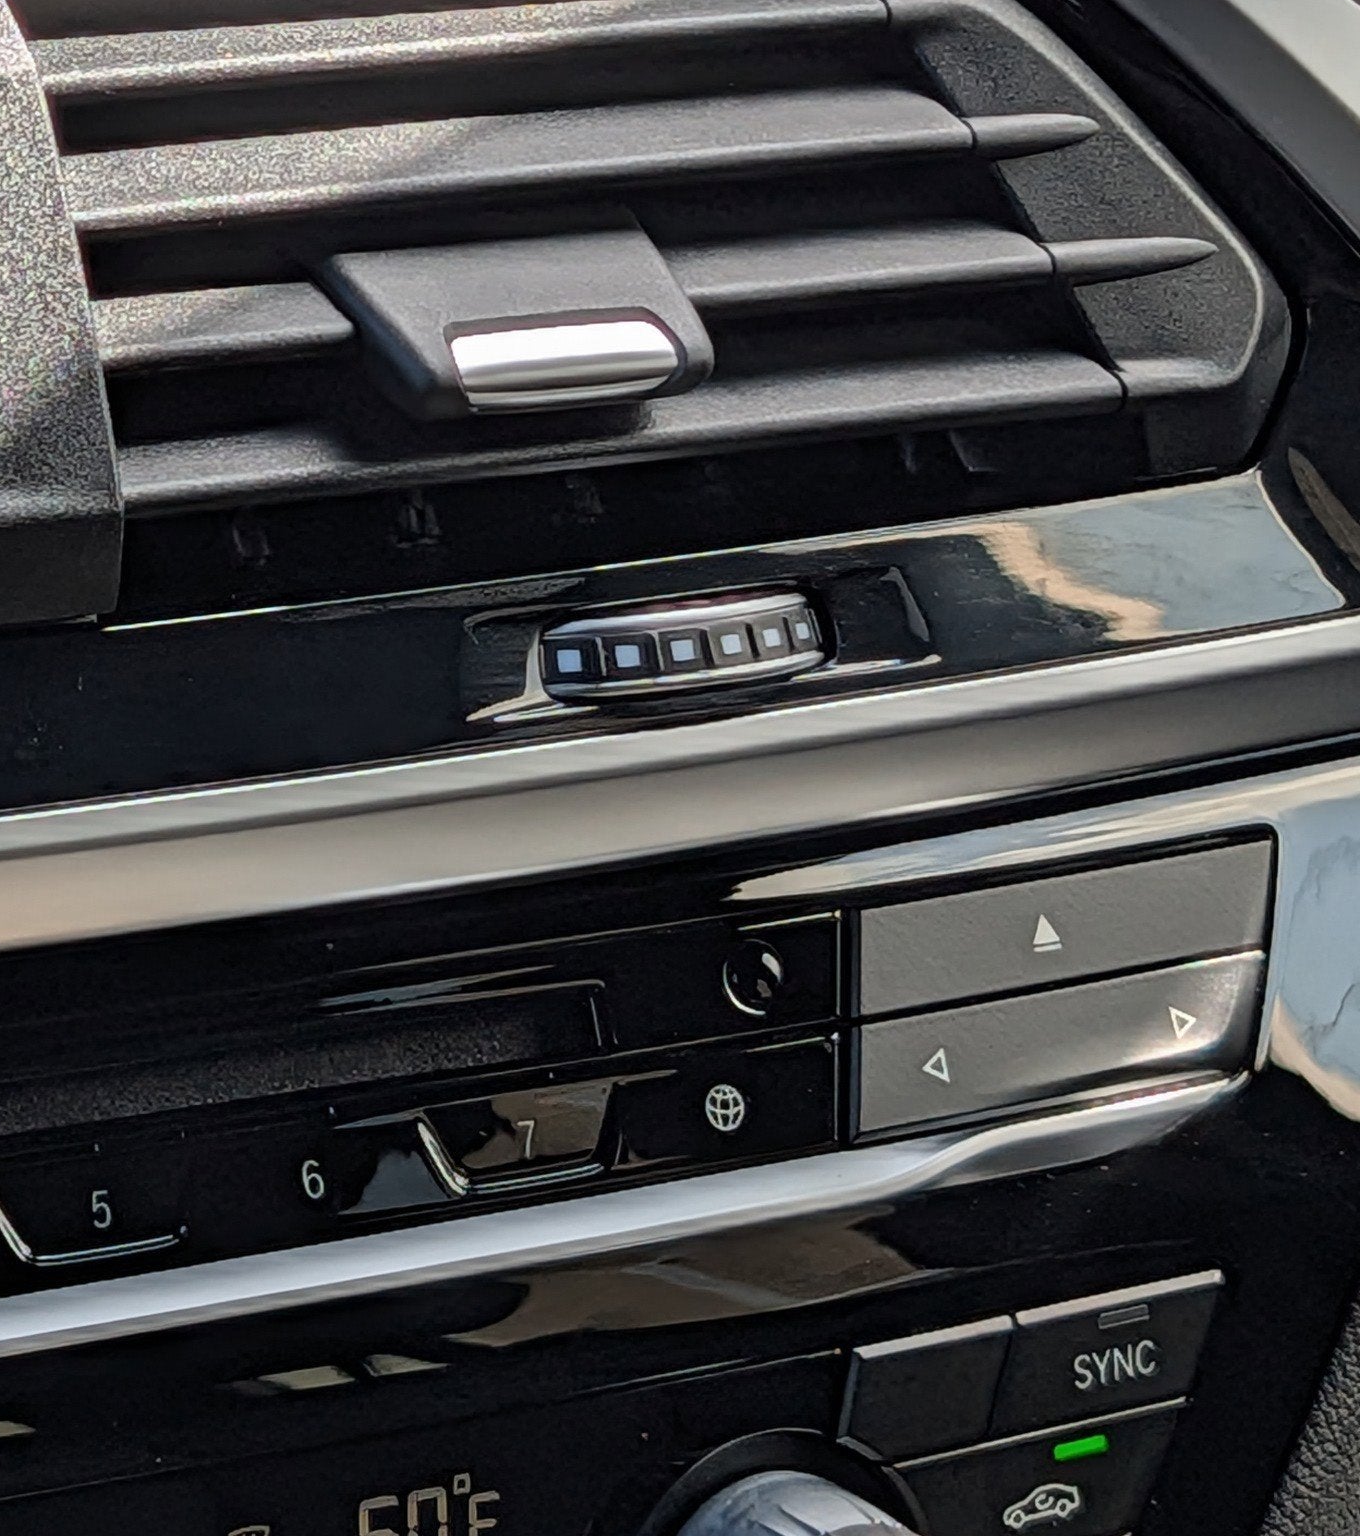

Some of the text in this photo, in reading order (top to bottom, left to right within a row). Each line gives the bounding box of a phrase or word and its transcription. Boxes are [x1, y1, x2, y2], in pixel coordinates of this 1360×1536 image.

[92, 1189, 112, 1228] 5
[301, 1160, 326, 1200] 6
[517, 1120, 536, 1158] 7
[1073, 1338, 1158, 1391] SYNC
